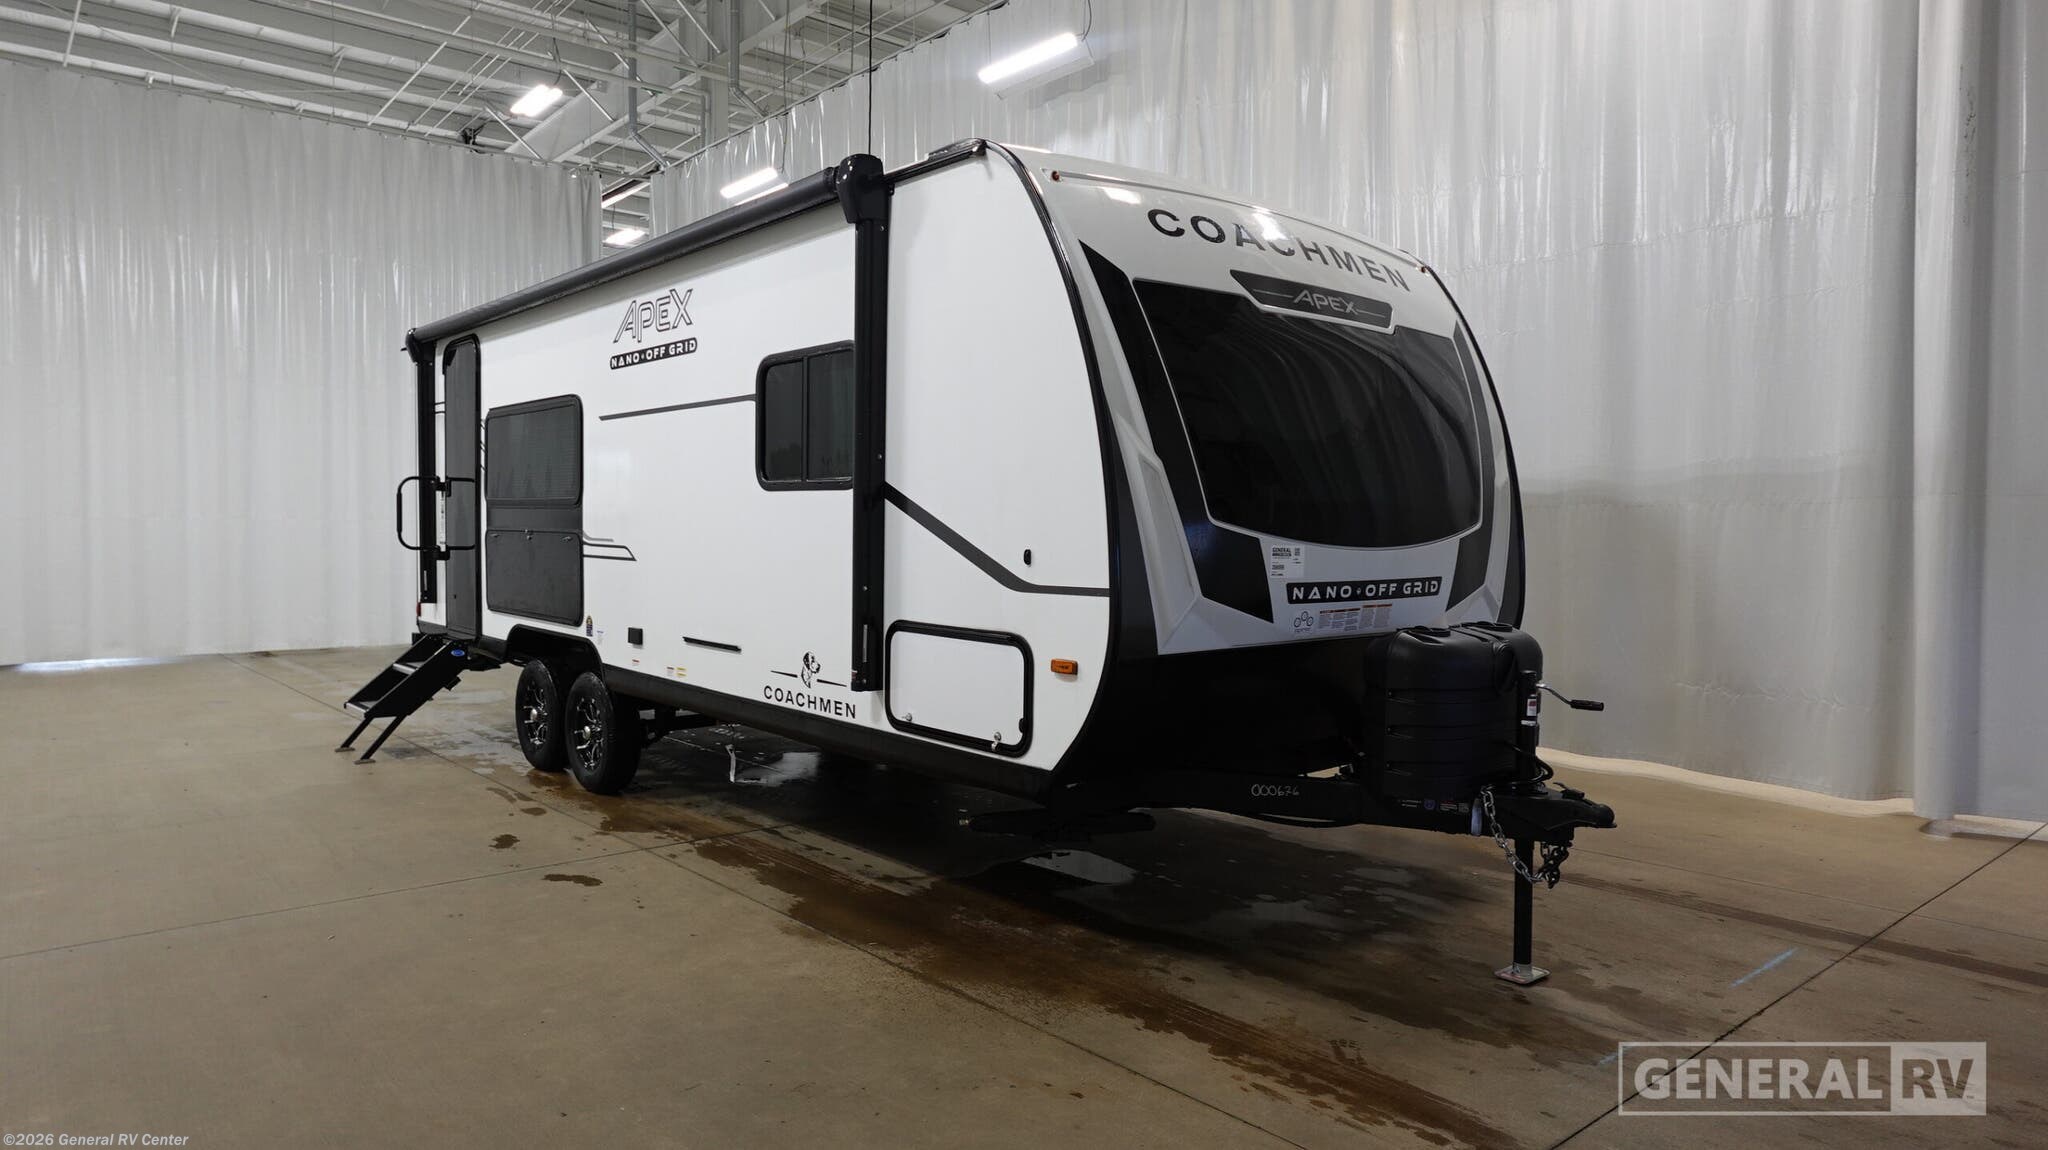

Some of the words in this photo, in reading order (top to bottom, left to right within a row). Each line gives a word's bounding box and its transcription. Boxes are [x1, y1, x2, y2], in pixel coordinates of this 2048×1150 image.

[1147, 208, 1411, 292] COACHMEN
[613, 288, 694, 344] APEX
[1293, 288, 1357, 315] APEX
[611, 353, 640, 368] NANO
[646, 346, 665, 360] OFF
[669, 340, 696, 356] GRID
[1292, 585, 1352, 600] NANO
[1365, 583, 1397, 596] OFF
[1402, 580, 1439, 594] GRID
[763, 685, 856, 719] COACHMEN
